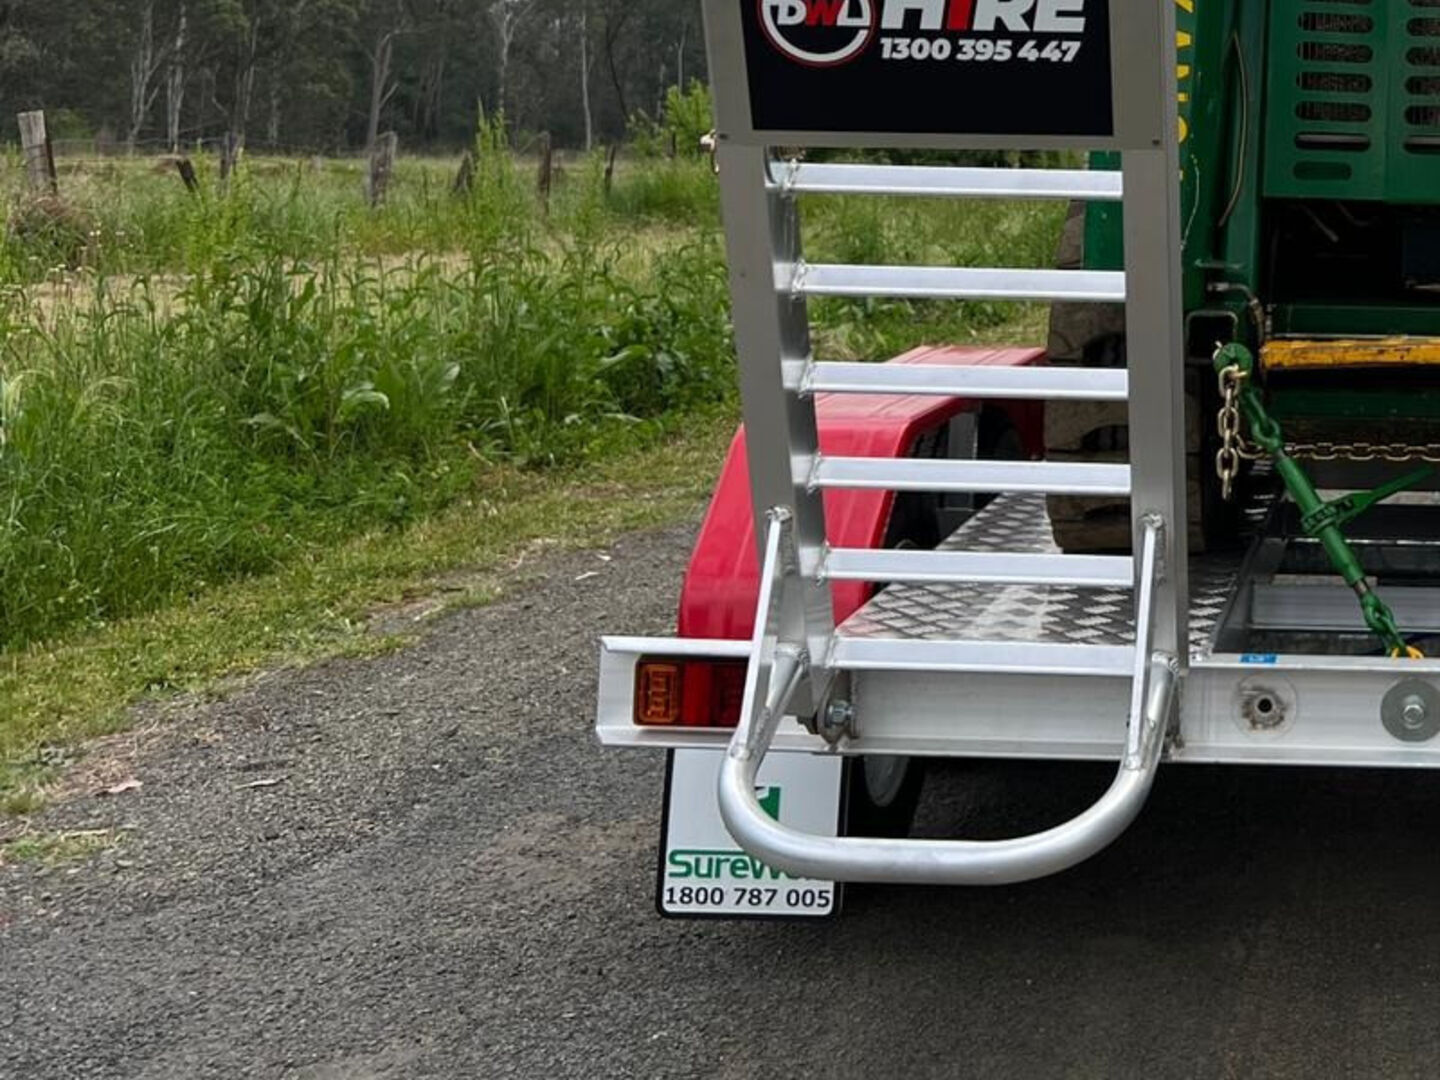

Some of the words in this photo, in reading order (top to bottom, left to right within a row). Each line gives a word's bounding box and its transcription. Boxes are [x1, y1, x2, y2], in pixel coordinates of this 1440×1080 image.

[881, 38, 951, 60] 1300
[955, 39, 1012, 61] 395
[1017, 40, 1081, 63] 447
[666, 887, 724, 906] 1800
[734, 888, 778, 906] 787
[786, 889, 830, 908] 005
